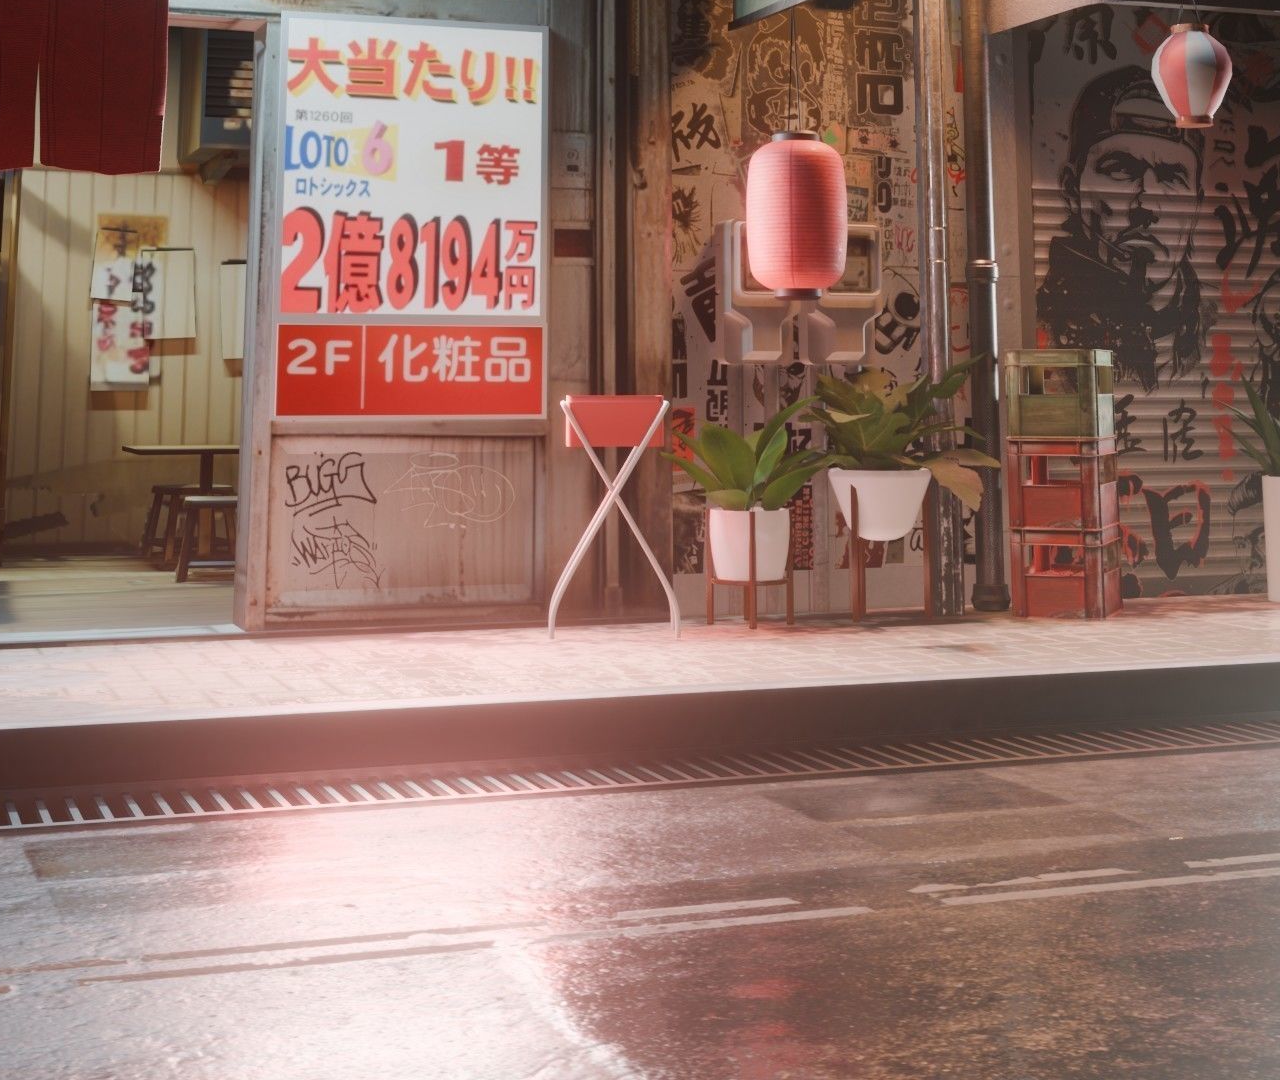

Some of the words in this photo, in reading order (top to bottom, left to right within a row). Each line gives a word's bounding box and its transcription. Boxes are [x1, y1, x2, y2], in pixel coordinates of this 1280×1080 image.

[287, 38, 538, 105] 大当たり!!
[284, 125, 349, 171] LOTO
[362, 120, 394, 176] 6
[295, 177, 371, 198] ロトシックス
[285, 339, 354, 376] 2F
[378, 333, 532, 384] 化粧品
